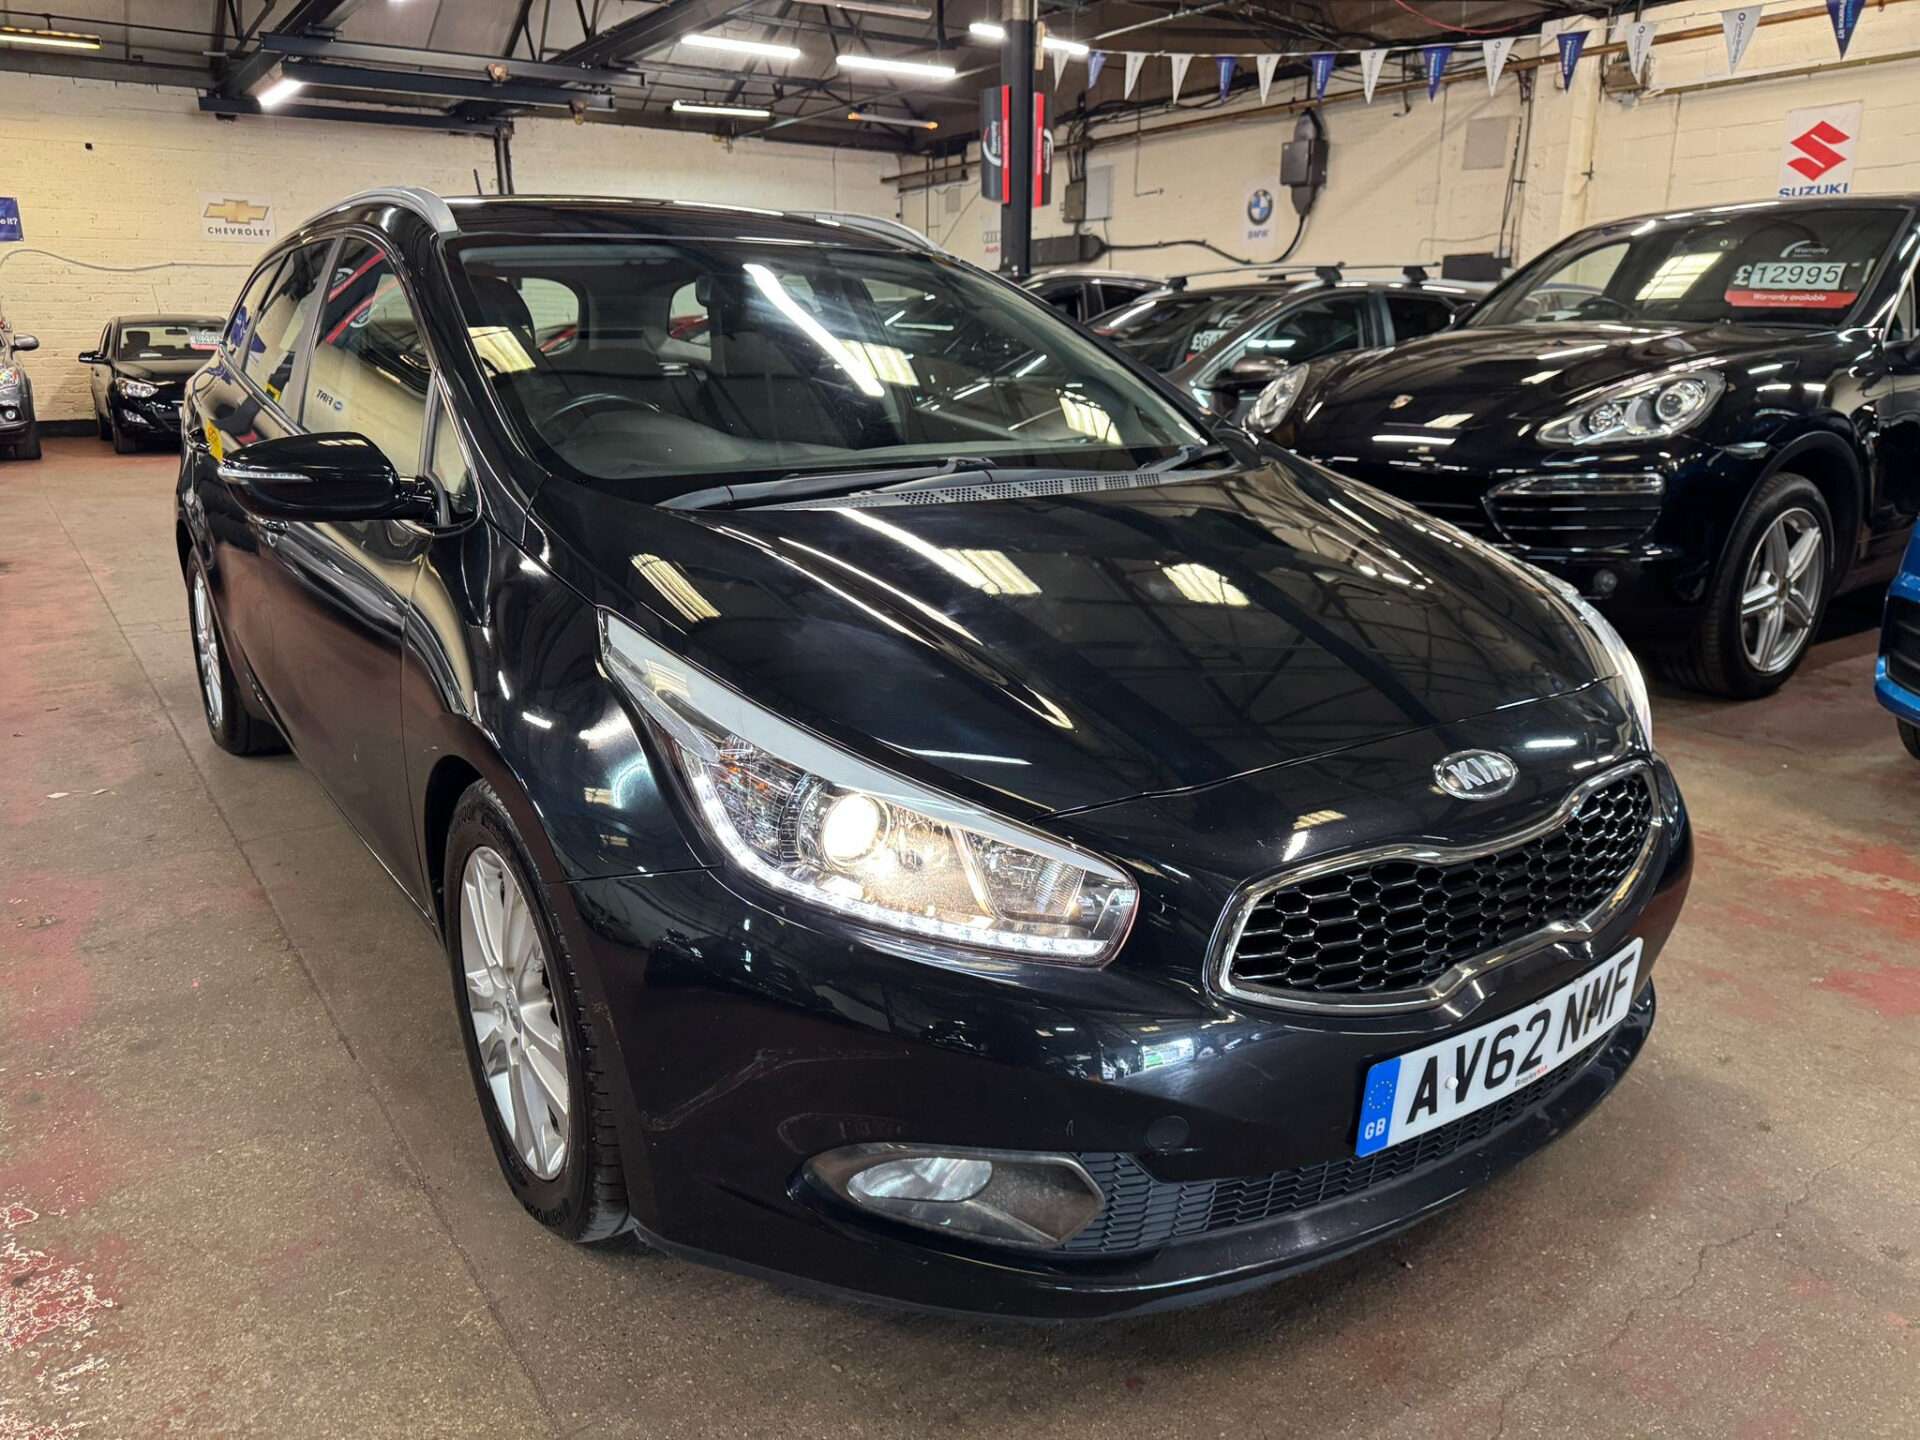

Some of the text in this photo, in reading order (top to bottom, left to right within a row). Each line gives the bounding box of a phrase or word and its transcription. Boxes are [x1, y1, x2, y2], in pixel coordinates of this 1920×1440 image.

[1779, 183, 1848, 197] SUZUKI
[207, 226, 272, 237] CHEVROLET
[1752, 293, 1787, 303] Warranty
[1446, 755, 1512, 790] KIA
[1405, 951, 1636, 1125] AV62 NMF
[1364, 1118, 1386, 1140] GB
